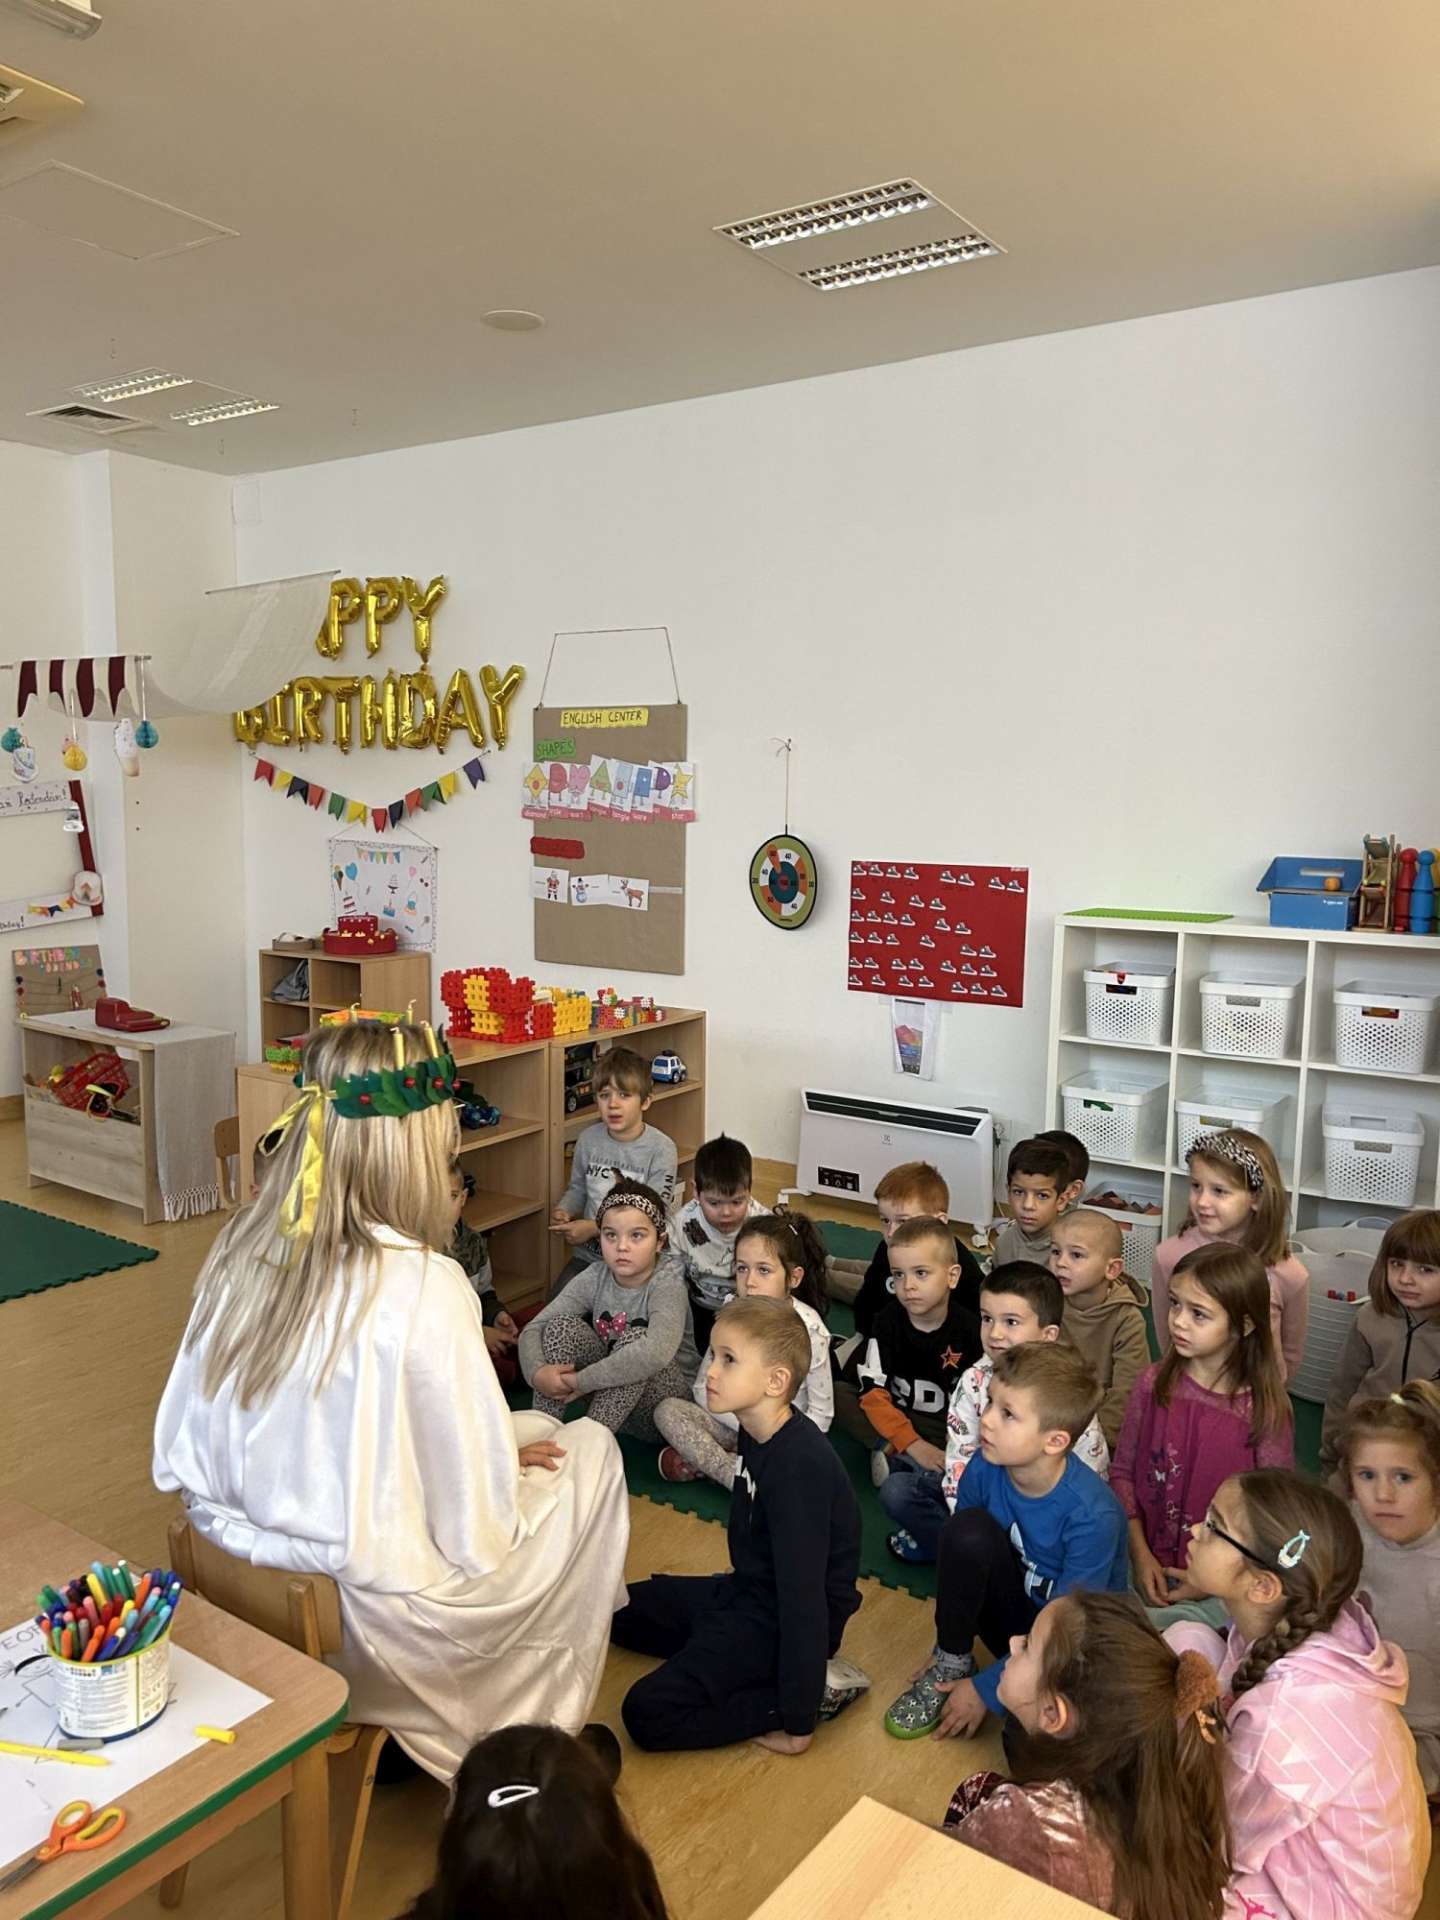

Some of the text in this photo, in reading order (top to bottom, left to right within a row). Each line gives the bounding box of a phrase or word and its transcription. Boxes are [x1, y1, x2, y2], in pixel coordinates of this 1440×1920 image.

[315, 575, 447, 662] PPY
[563, 710, 642, 725] ENGLISH CENTER
[536, 741, 574, 757] SHAPES
[586, 1164, 610, 1179] NYC
[660, 1174, 674, 1200] NYC
